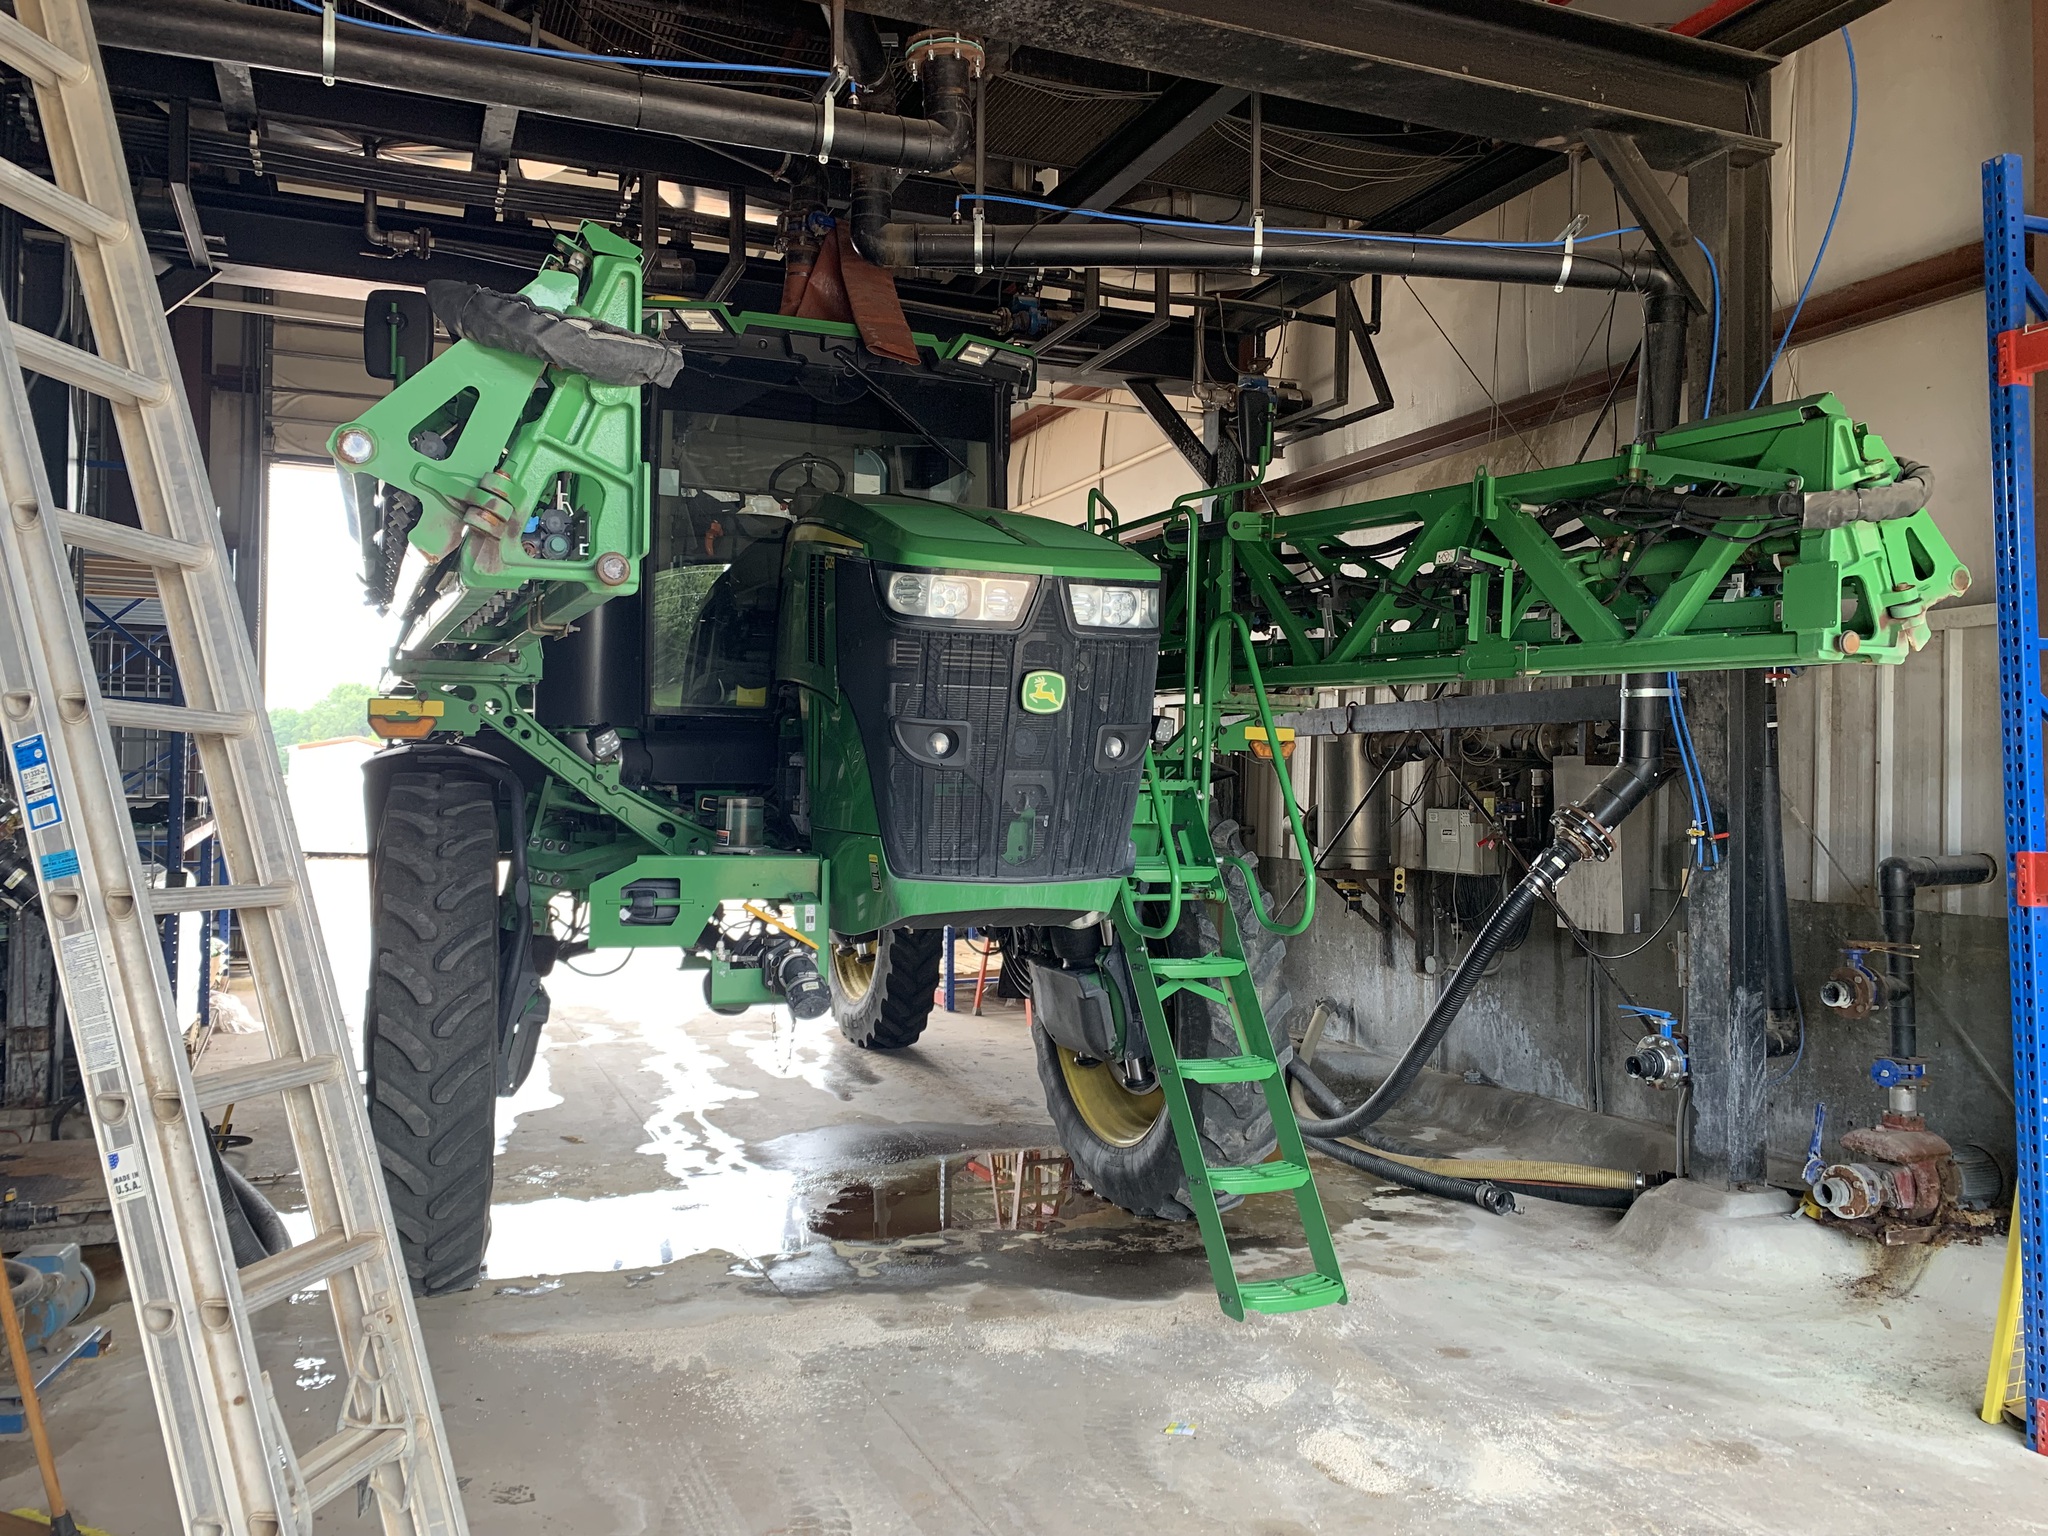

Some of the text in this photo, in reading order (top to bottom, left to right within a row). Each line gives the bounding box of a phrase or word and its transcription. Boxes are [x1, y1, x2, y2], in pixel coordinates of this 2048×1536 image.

[113, 1171, 139, 1184] MADE IN
[116, 1181, 141, 1195] U.S.A.
